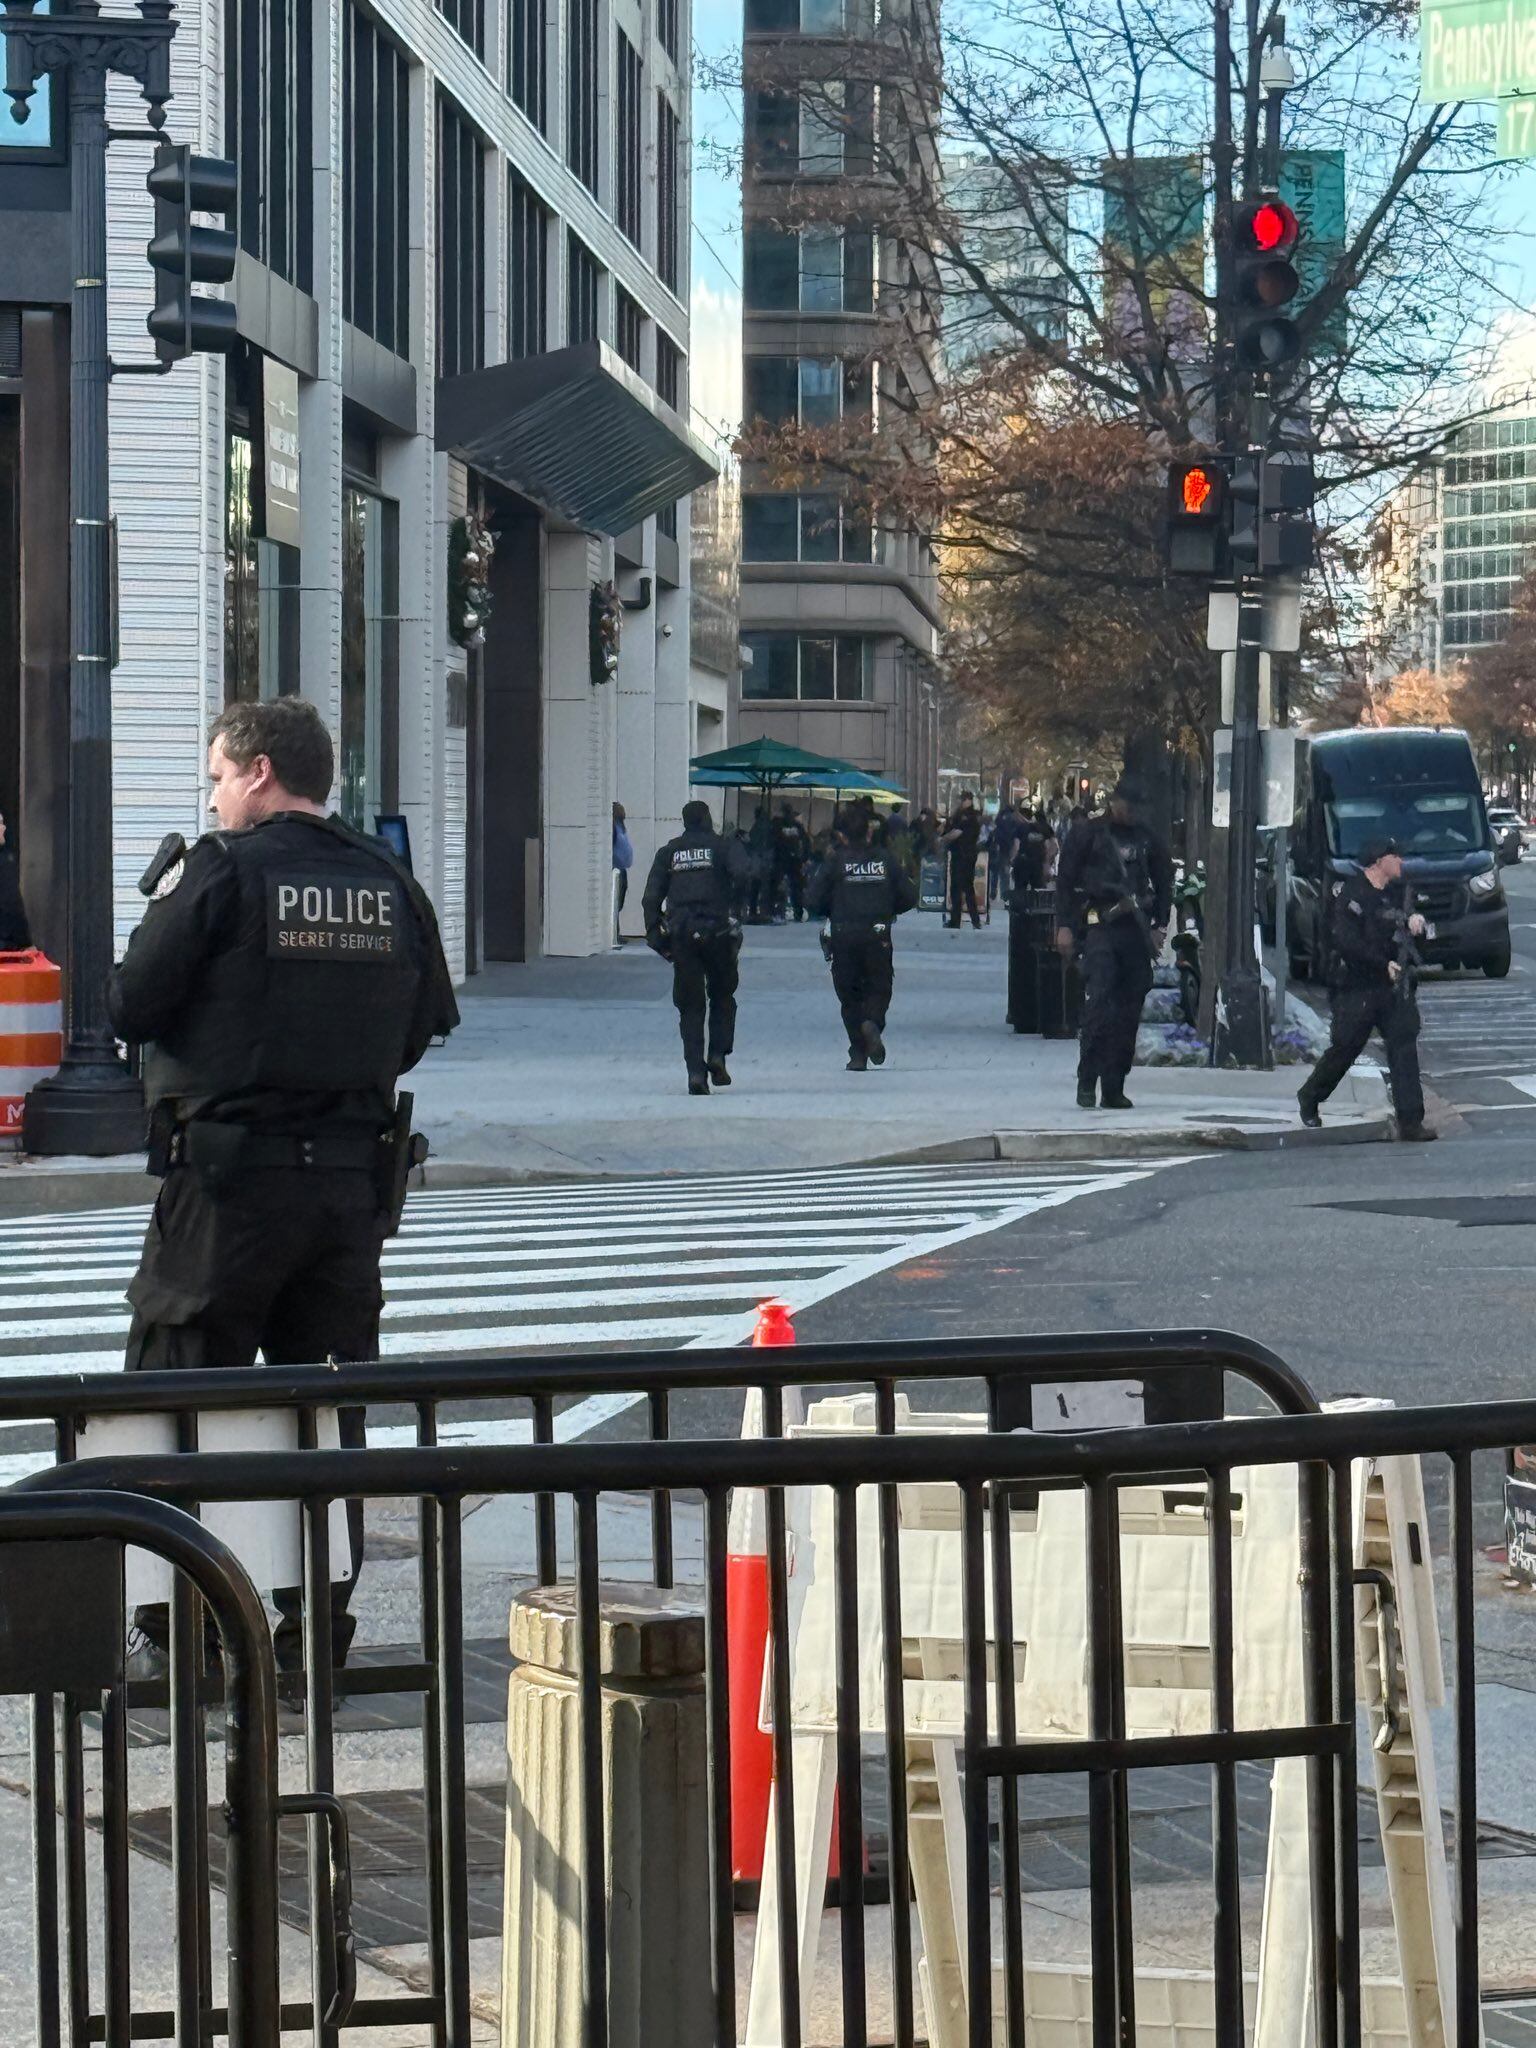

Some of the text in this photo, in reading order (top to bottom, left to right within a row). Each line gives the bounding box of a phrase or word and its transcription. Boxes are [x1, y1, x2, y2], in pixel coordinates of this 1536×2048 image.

[673, 848, 712, 862] POLICE
[278, 885, 392, 926] POLICE
[278, 931, 392, 952] SECRET SERVICE
